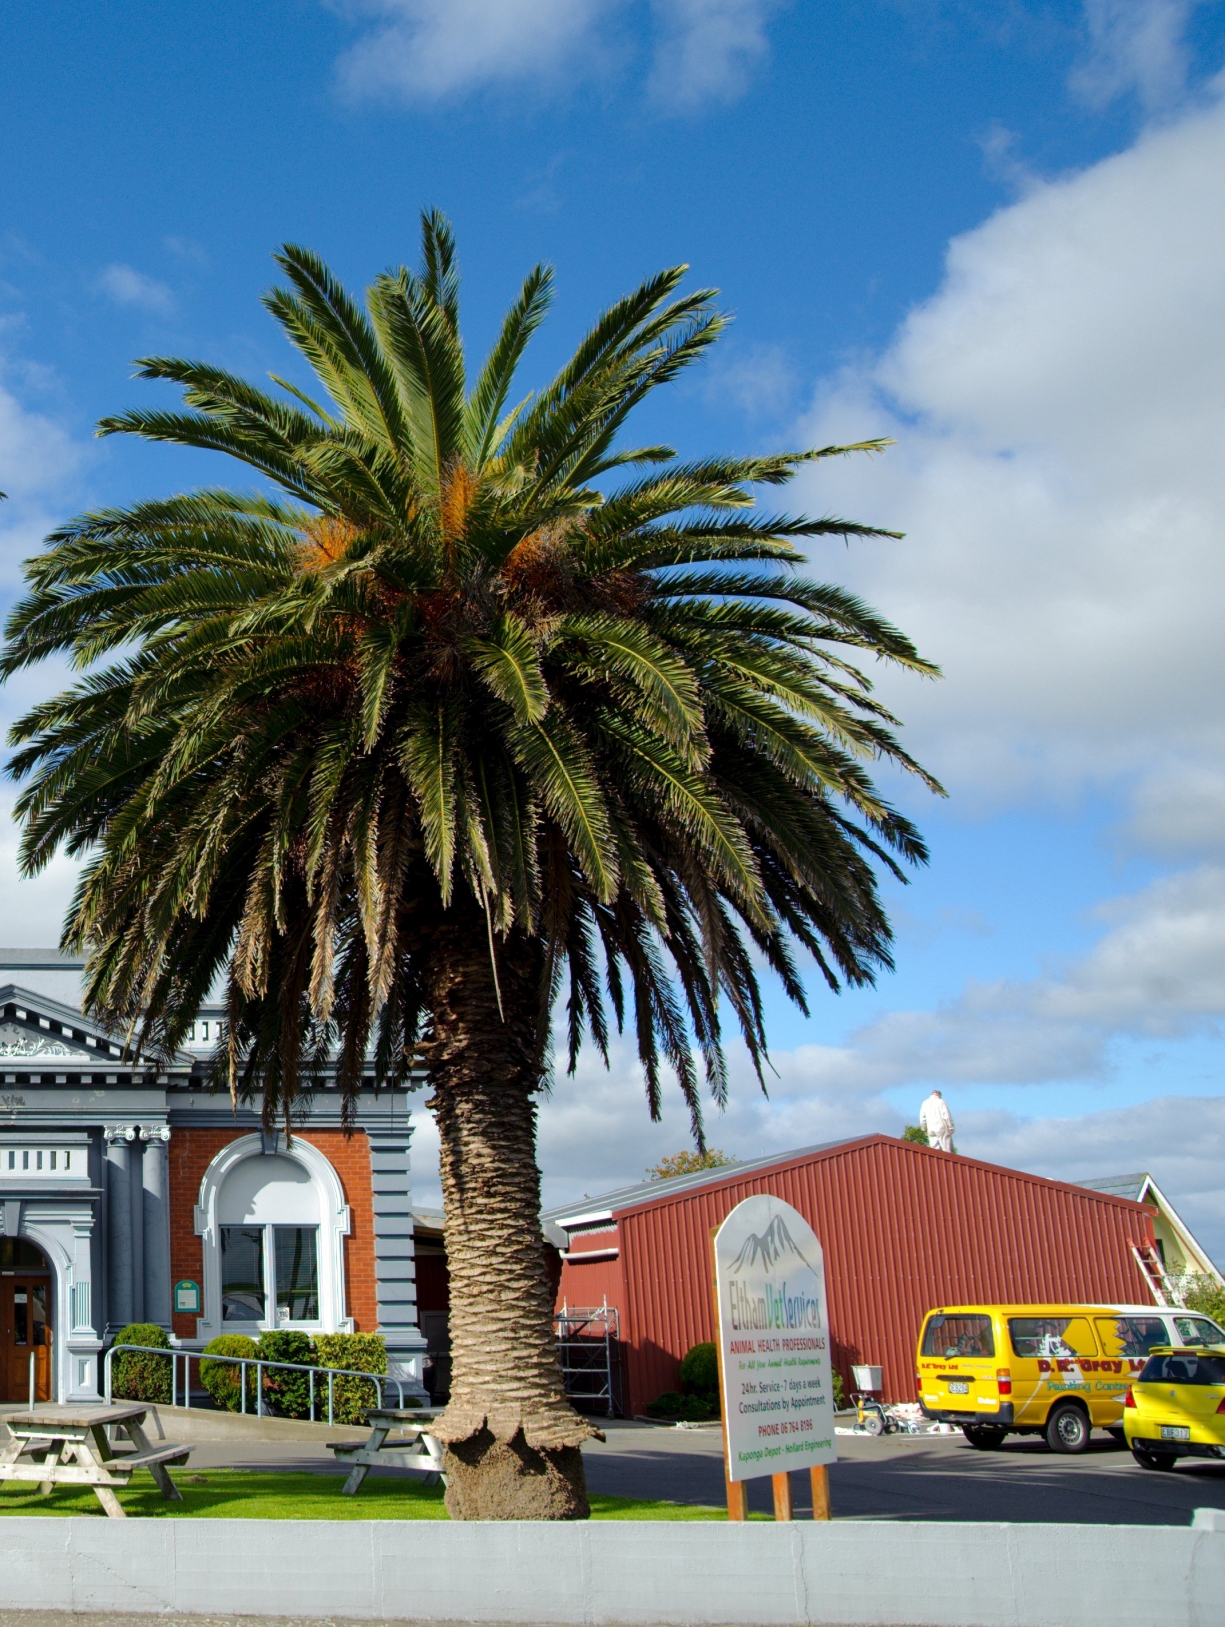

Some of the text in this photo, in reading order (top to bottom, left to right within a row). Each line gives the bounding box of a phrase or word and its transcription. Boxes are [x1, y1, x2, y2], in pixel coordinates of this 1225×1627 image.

[730, 1337, 825, 1354] ANIMAL HEALTH PROFESSIONALS
[738, 1361, 746, 1370] For
[768, 1358, 782, 1367] Animal
[783, 1357, 797, 1366] Health
[1079, 1359, 1123, 1374] Gray
[789, 1378, 802, 1393] days
[803, 1380, 806, 1389] a
[808, 1377, 822, 1389] week
[1047, 1381, 1091, 1393] Painting
[739, 1394, 826, 1414] Consultations by Appointment
[758, 1419, 813, 1437] PHONE 06 764 8196
[738, 1449, 763, 1462] Kaponga
[764, 1446, 781, 1459] Depot
[785, 1441, 804, 1454] Hollard
[804, 1438, 832, 1452] Engineering
